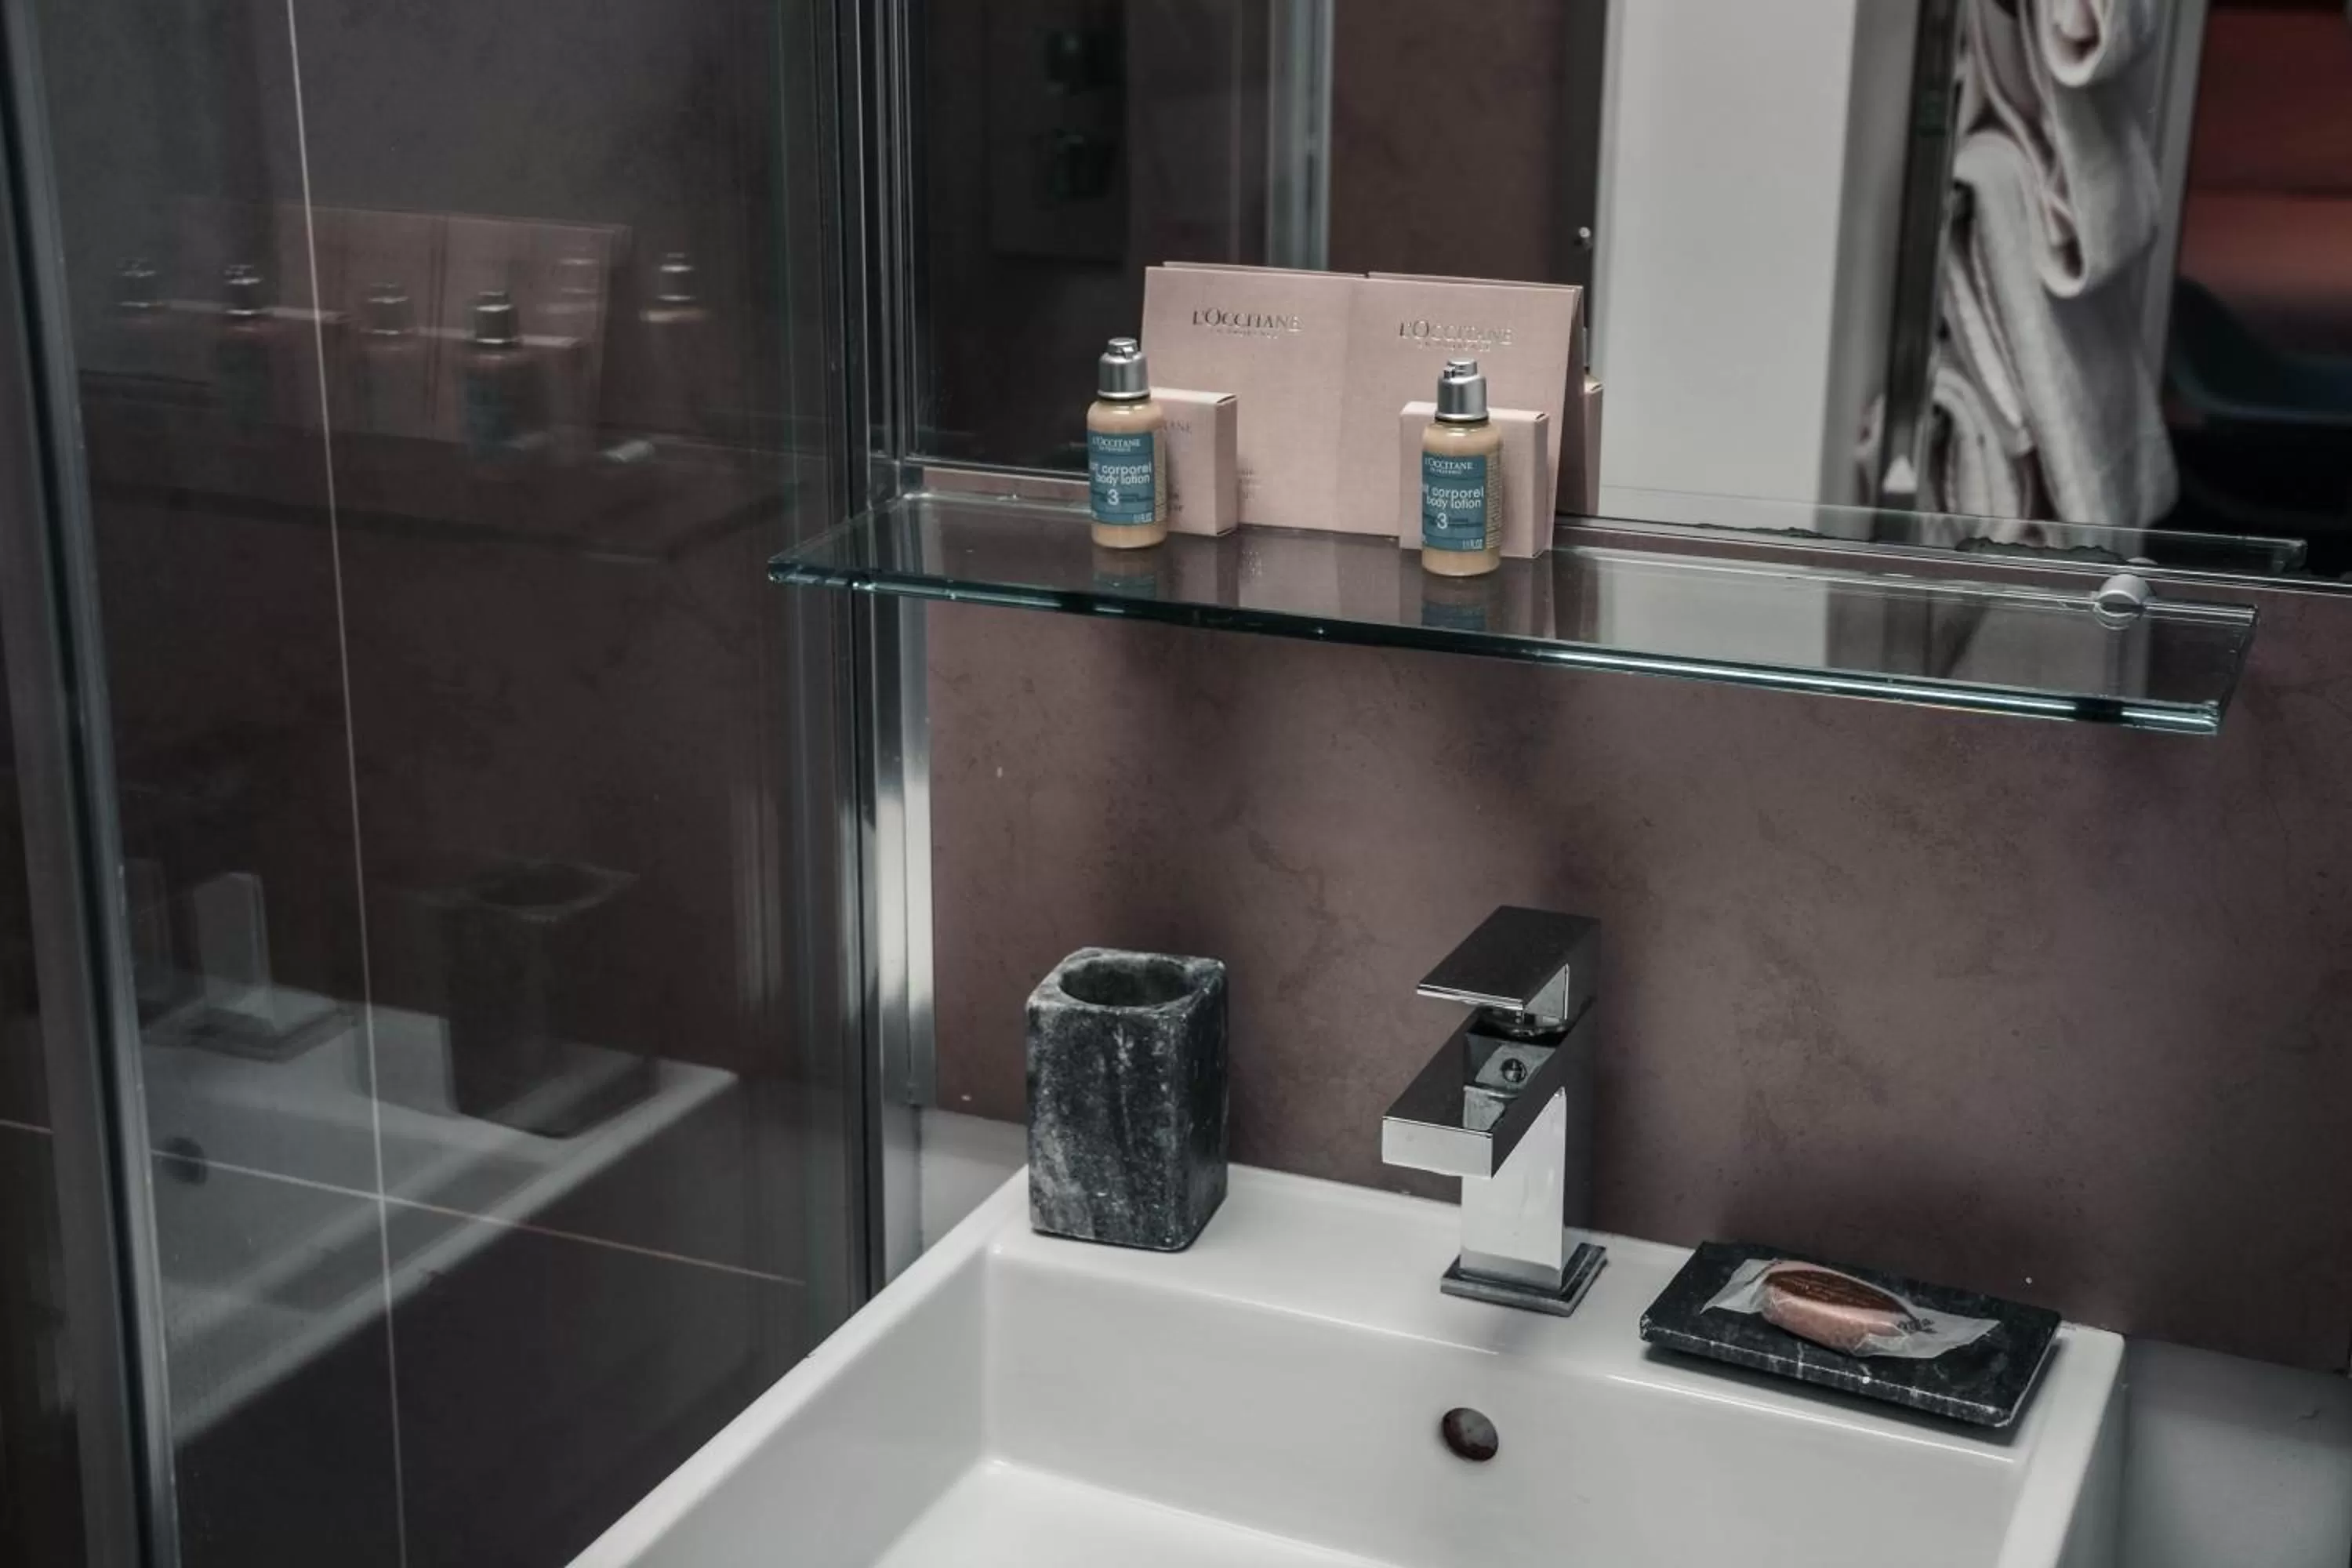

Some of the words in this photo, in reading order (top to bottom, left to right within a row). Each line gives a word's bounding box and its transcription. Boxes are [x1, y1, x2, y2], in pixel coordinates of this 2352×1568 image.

[1192, 307, 1305, 332] L'OCCITANE
[1101, 461, 1152, 476] corporel
[1096, 471, 1119, 487] body
[1120, 472, 1151, 485] lotion
[1108, 488, 1120, 506] 3
[1432, 486, 1484, 499] corporel
[1426, 495, 1448, 510] body
[1451, 495, 1482, 509] lotion
[1436, 513, 1448, 529] 3
